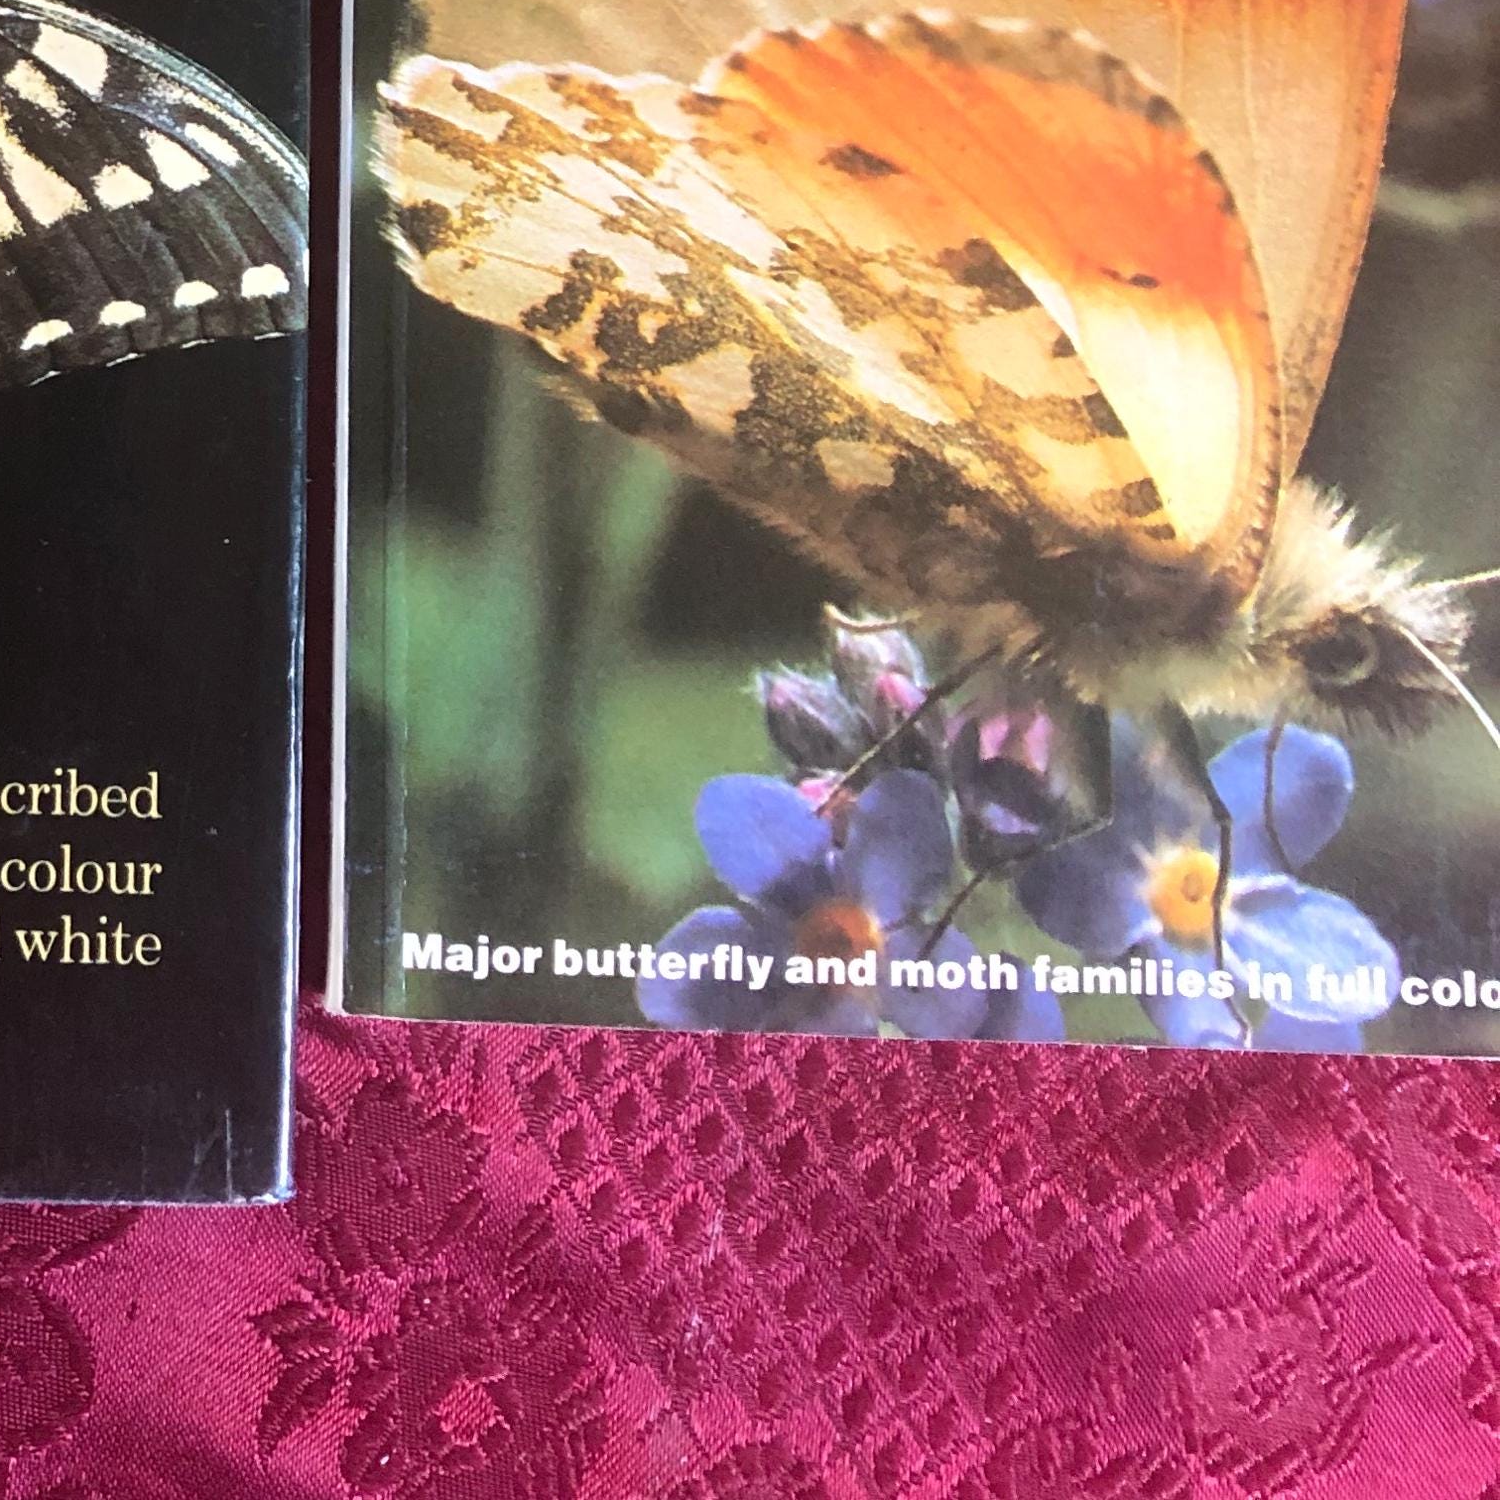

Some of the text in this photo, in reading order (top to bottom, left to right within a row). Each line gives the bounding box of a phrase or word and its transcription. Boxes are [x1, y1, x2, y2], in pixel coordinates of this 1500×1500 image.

[0, 842, 164, 897] colour
[14, 913, 164, 968] white
[400, 932, 543, 980] Major
[553, 938, 775, 991] butterfly
[784, 950, 877, 988] and
[890, 954, 1019, 992] moth
[1031, 954, 1237, 1001] families
[1247, 960, 1294, 1002] in
[1305, 964, 1388, 1003] full
